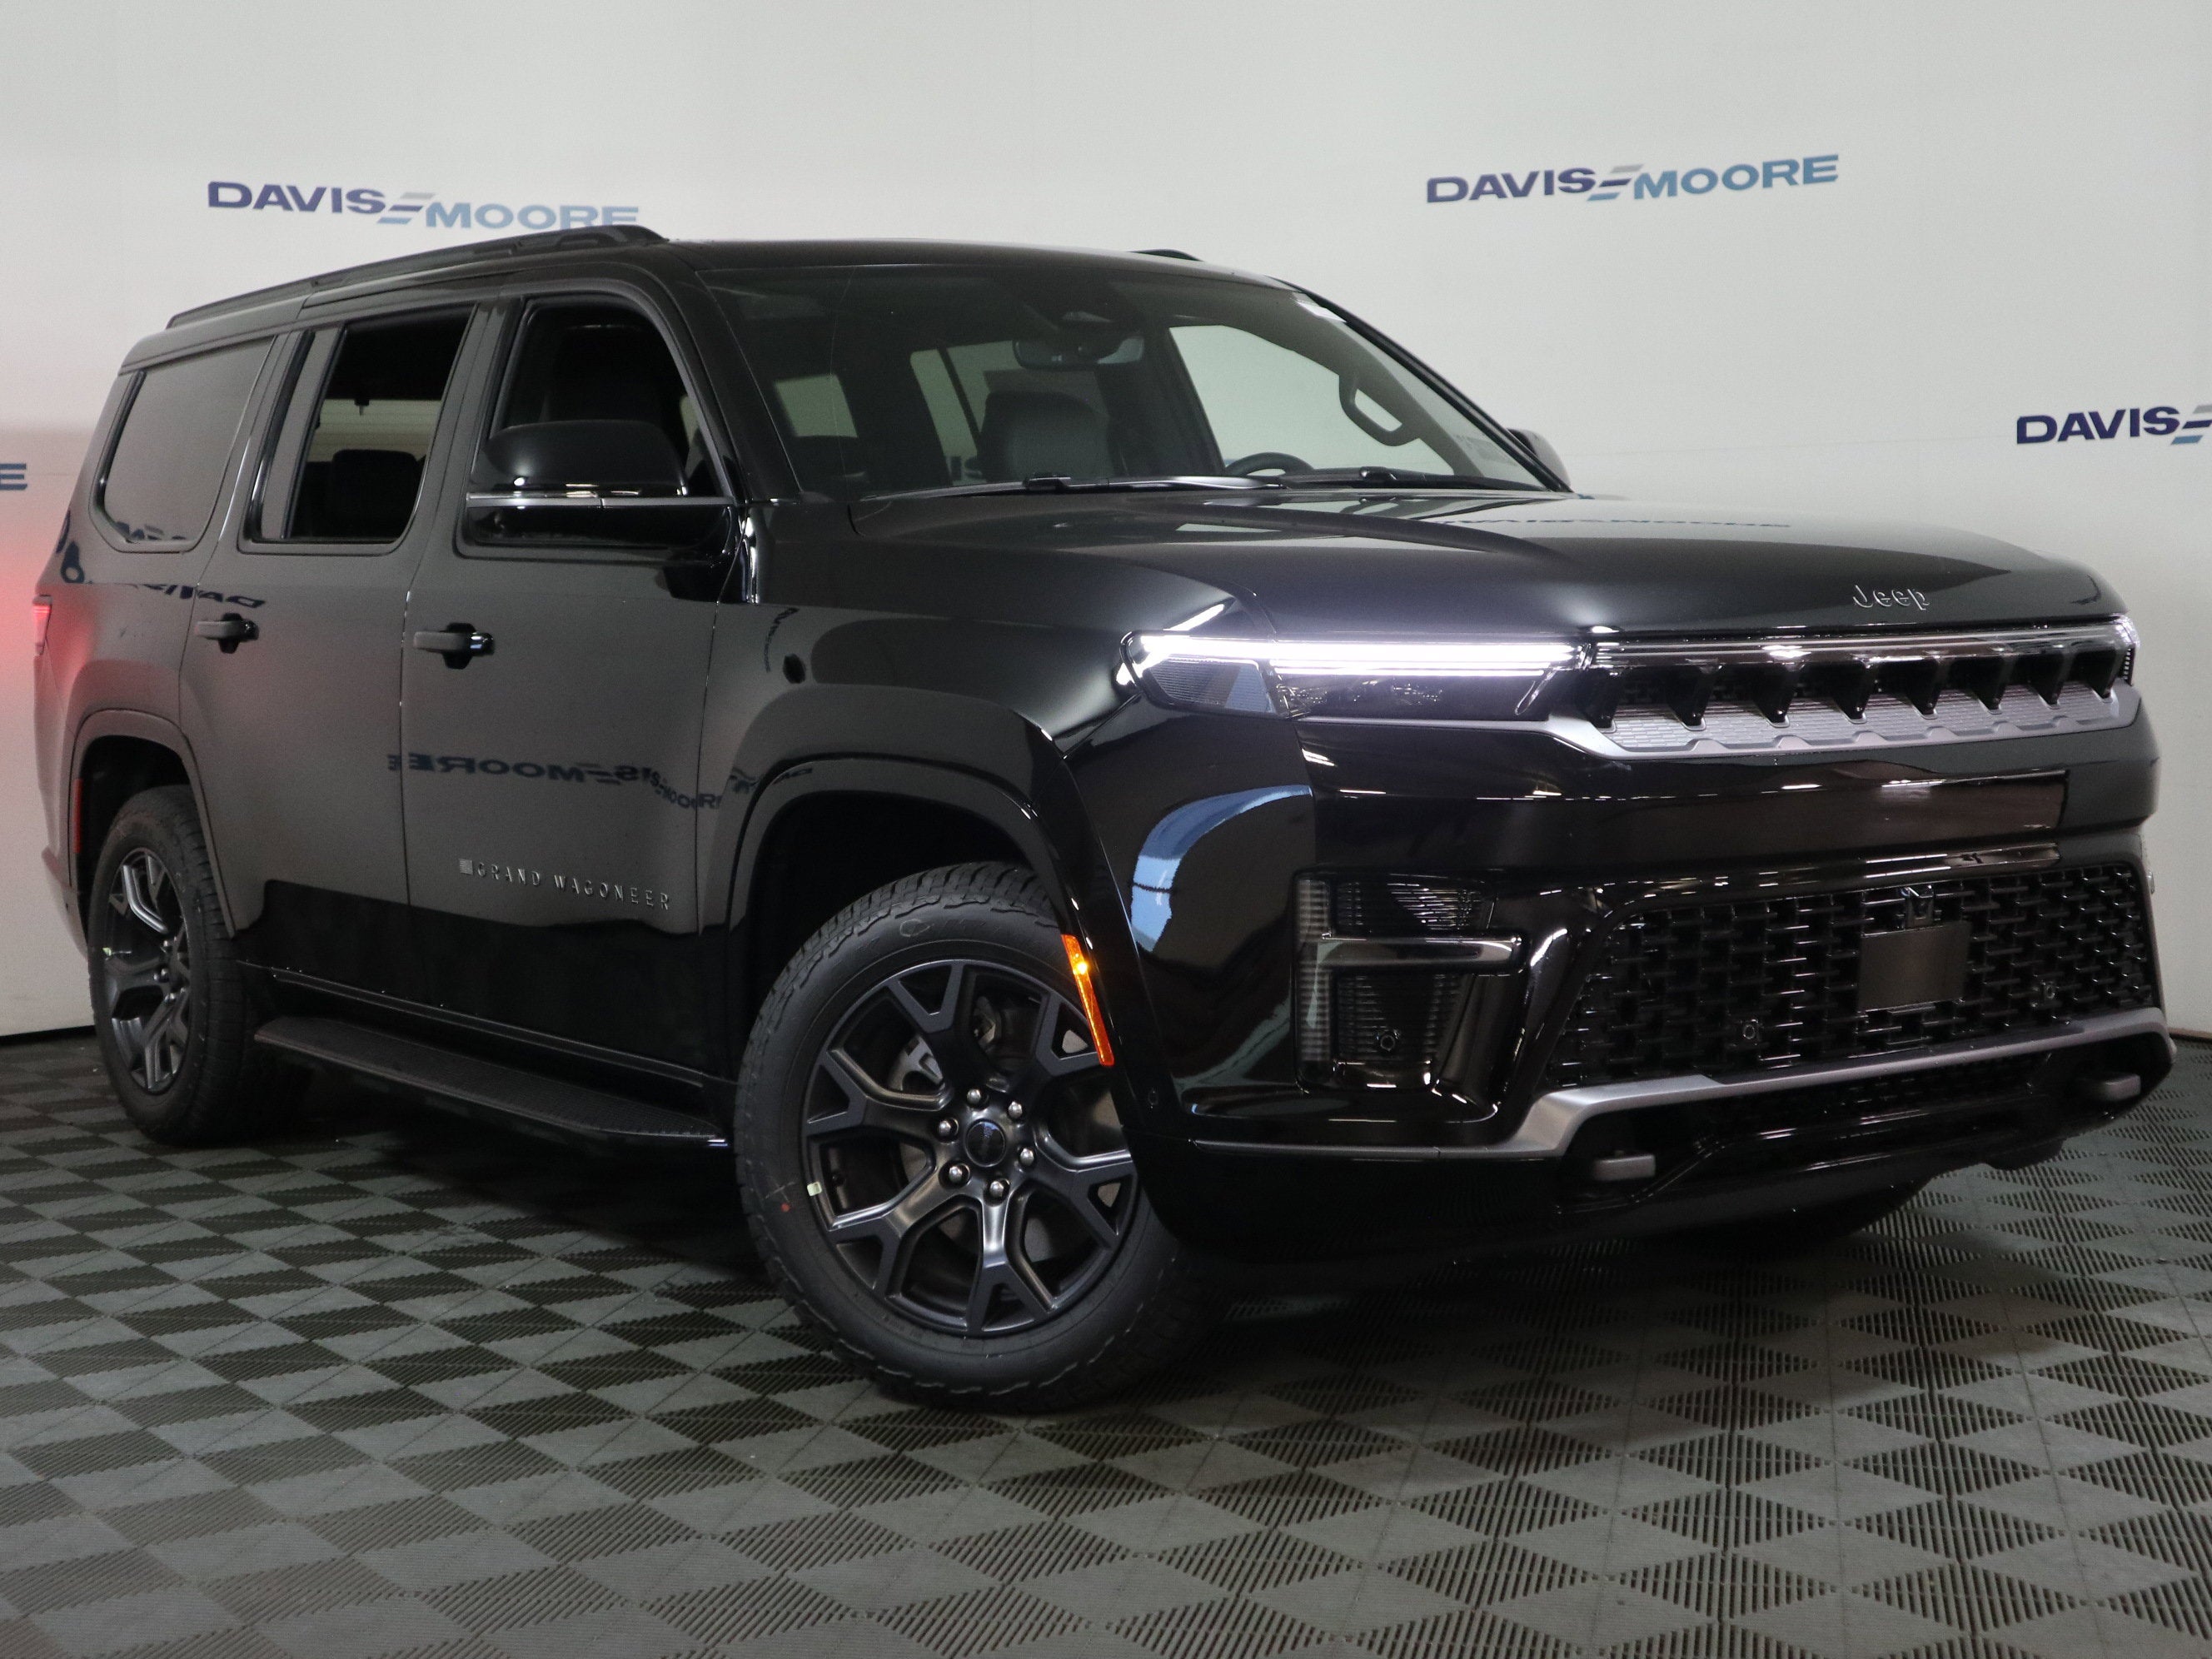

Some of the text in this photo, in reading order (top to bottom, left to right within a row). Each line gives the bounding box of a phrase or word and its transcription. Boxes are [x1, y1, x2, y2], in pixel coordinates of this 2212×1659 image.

[1427, 154, 1839, 202] DAVIS MOORE
[208, 181, 639, 229] DAVIS MOORE
[2016, 406, 2180, 445] DAVIS
[1852, 585, 1931, 610] Jeep
[477, 862, 670, 910] GRAND WAGONEER
